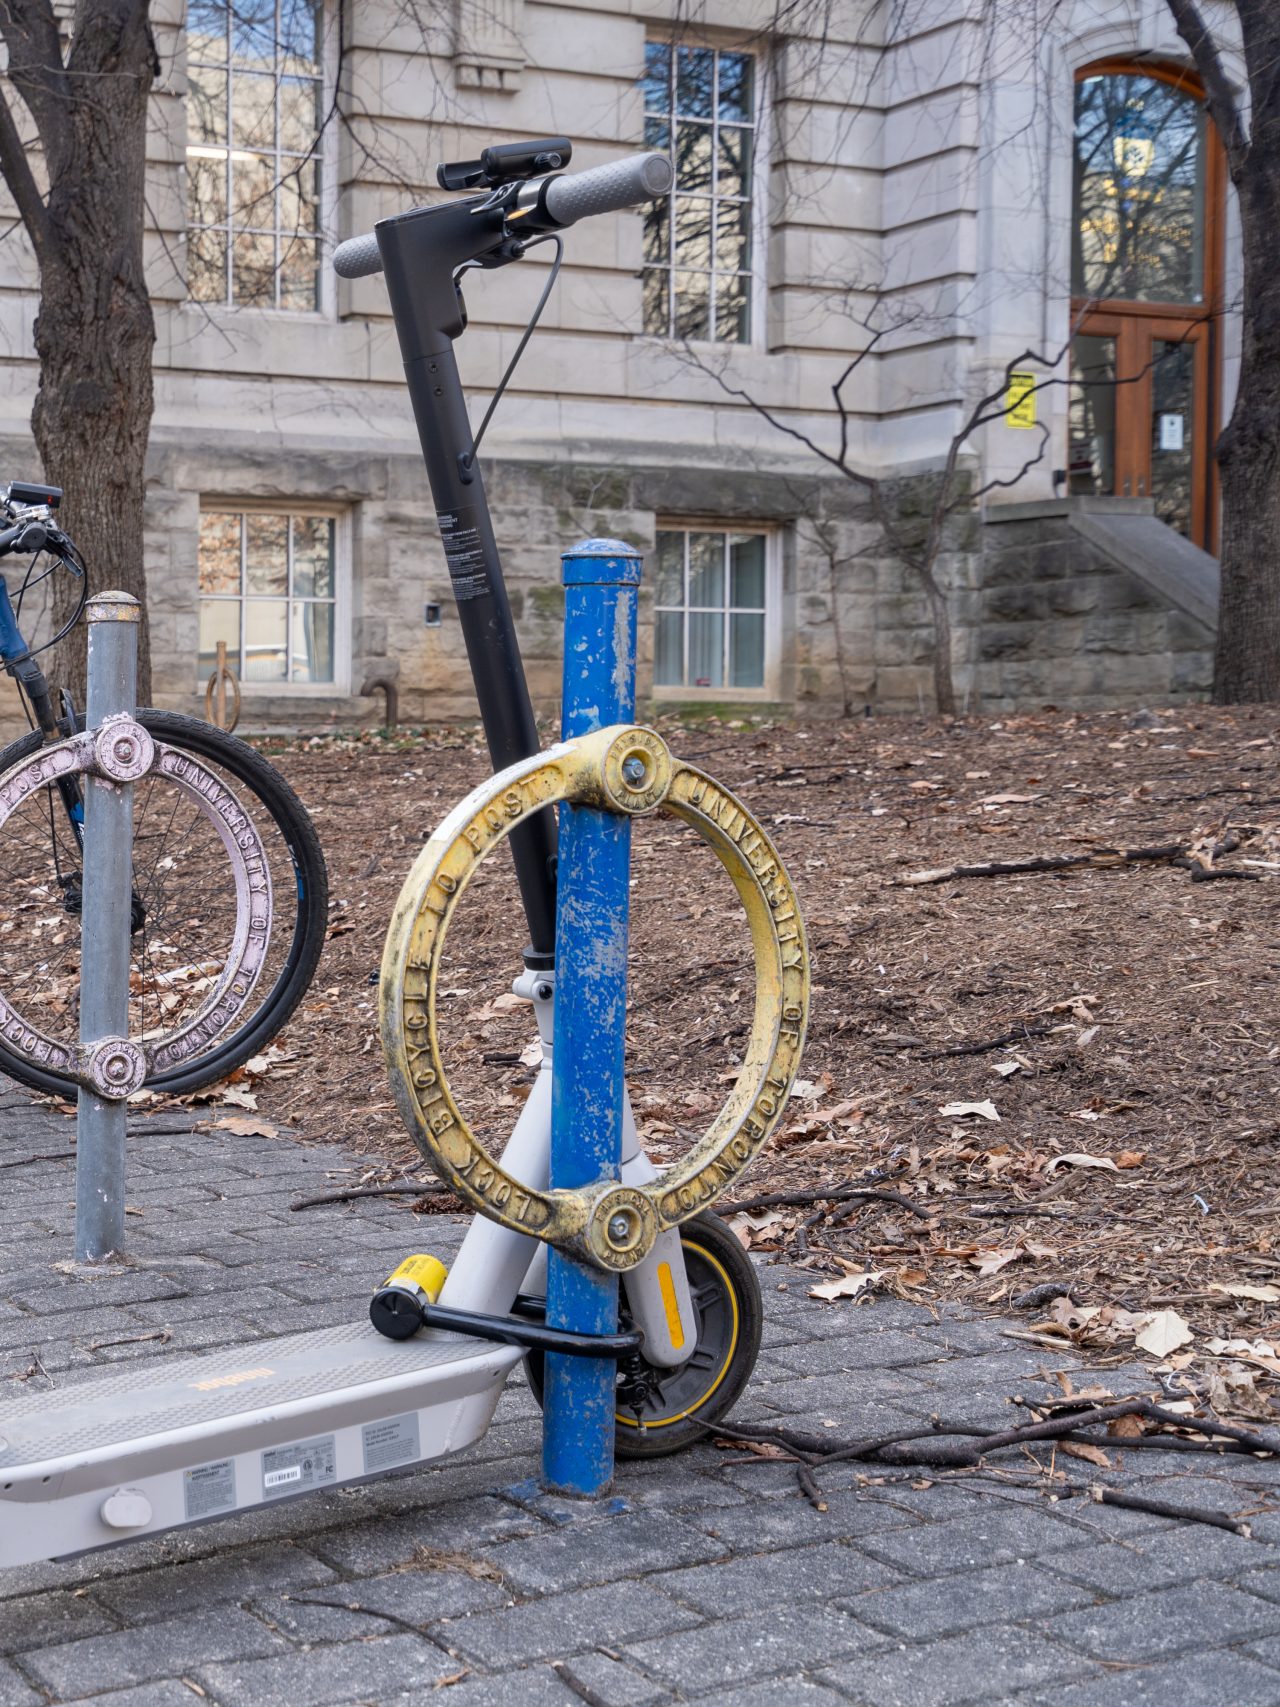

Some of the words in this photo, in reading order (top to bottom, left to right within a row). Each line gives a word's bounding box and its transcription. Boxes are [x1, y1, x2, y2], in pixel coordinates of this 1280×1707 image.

[175, 757, 268, 894] UNIVERSITY
[464, 775, 539, 855] POST
[419, 872, 457, 916] TO
[690, 776, 803, 970] UNIVERSITY
[249, 917, 267, 949] OF
[169, 967, 256, 1060] TORONTO
[404, 950, 456, 1136] BICYCLE
[780, 1004, 802, 1050] OF
[679, 1077, 789, 1210] TORONTO
[455, 1154, 531, 1220] LOCK
